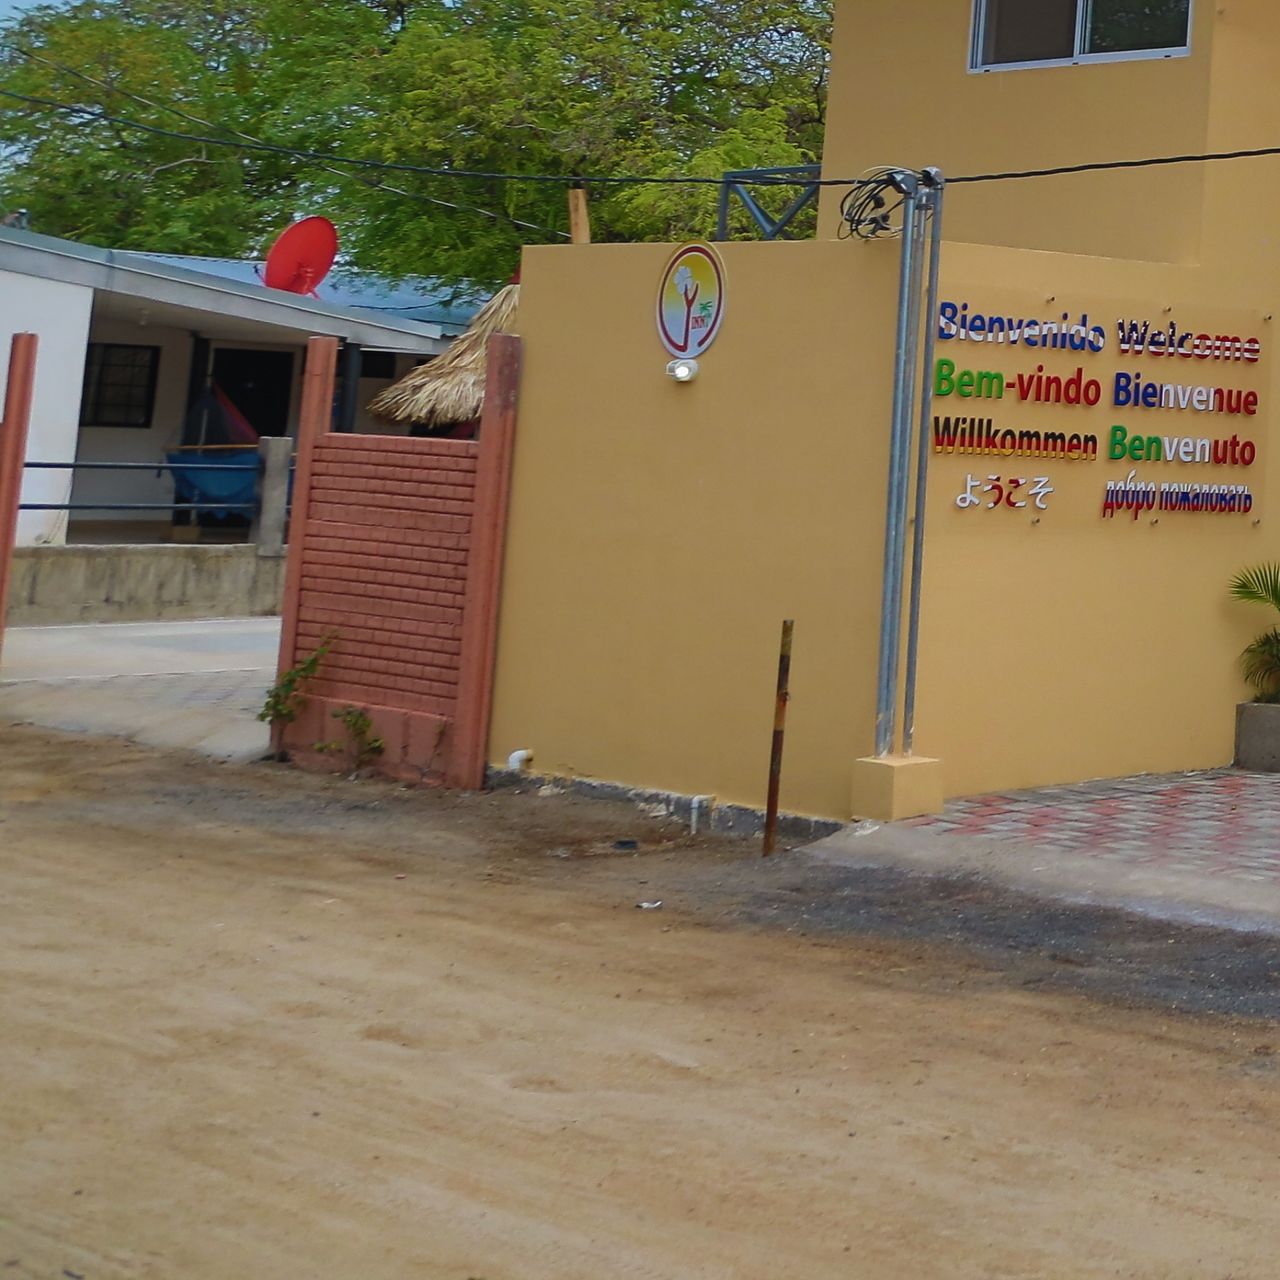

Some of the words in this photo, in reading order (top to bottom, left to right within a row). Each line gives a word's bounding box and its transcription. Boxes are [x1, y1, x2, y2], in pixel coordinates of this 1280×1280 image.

[938, 302, 1105, 352] Bienvenido
[1117, 318, 1260, 363] Welcome
[935, 358, 1101, 406] Bem-vindo
[1114, 372, 1258, 415] Bienvenue
[933, 416, 1098, 461] Willkommen
[1108, 425, 1256, 465] Benvenuto
[956, 474, 1054, 510] ようこそ
[1102, 469, 1157, 520] добро
[1159, 482, 1253, 513] пожаловать
